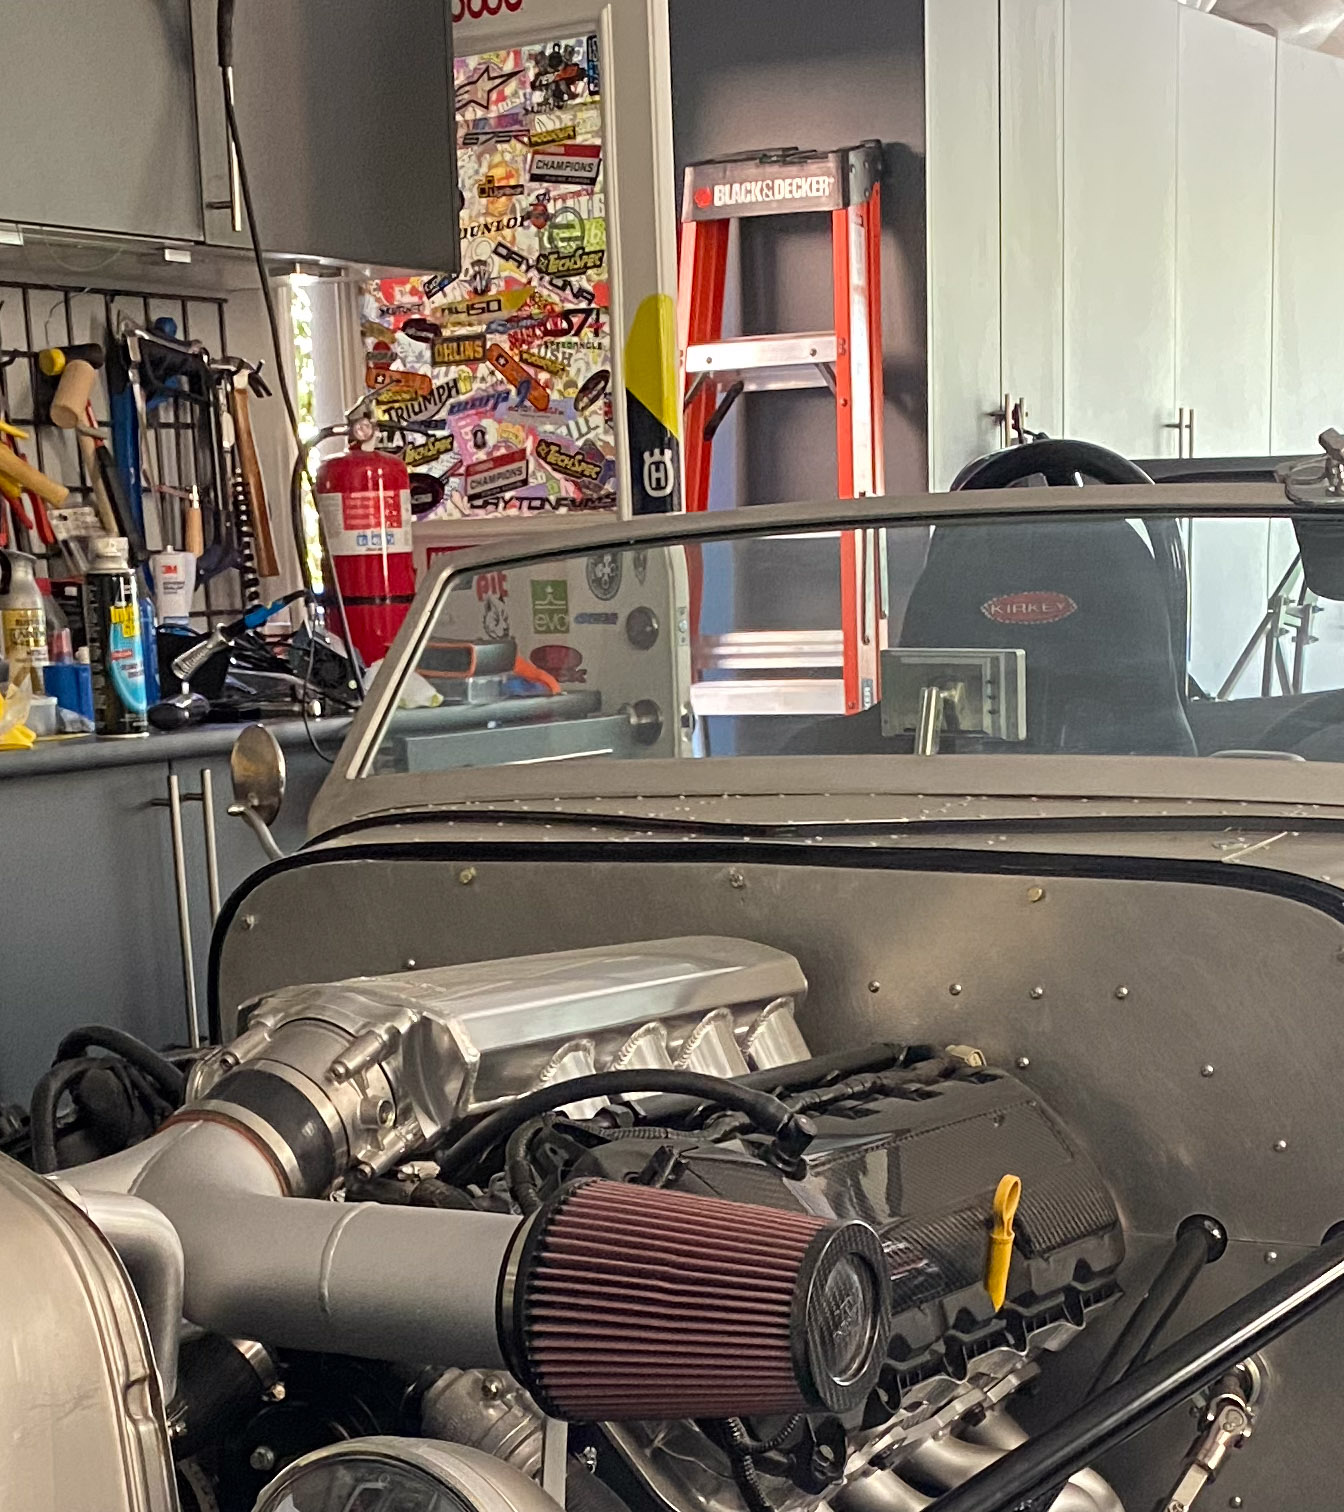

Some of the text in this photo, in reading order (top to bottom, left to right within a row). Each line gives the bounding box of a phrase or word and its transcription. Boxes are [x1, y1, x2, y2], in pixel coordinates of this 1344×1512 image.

[536, 160, 595, 172] CHAMPIONS
[713, 175, 833, 207] BLACK&DECKER
[383, 379, 461, 423] TRIUMPH
[470, 466, 523, 489] CHAMPIONS
[161, 565, 177, 574] 3M
[991, 602, 1067, 615] KIRKEY
[535, 613, 568, 630] evo
